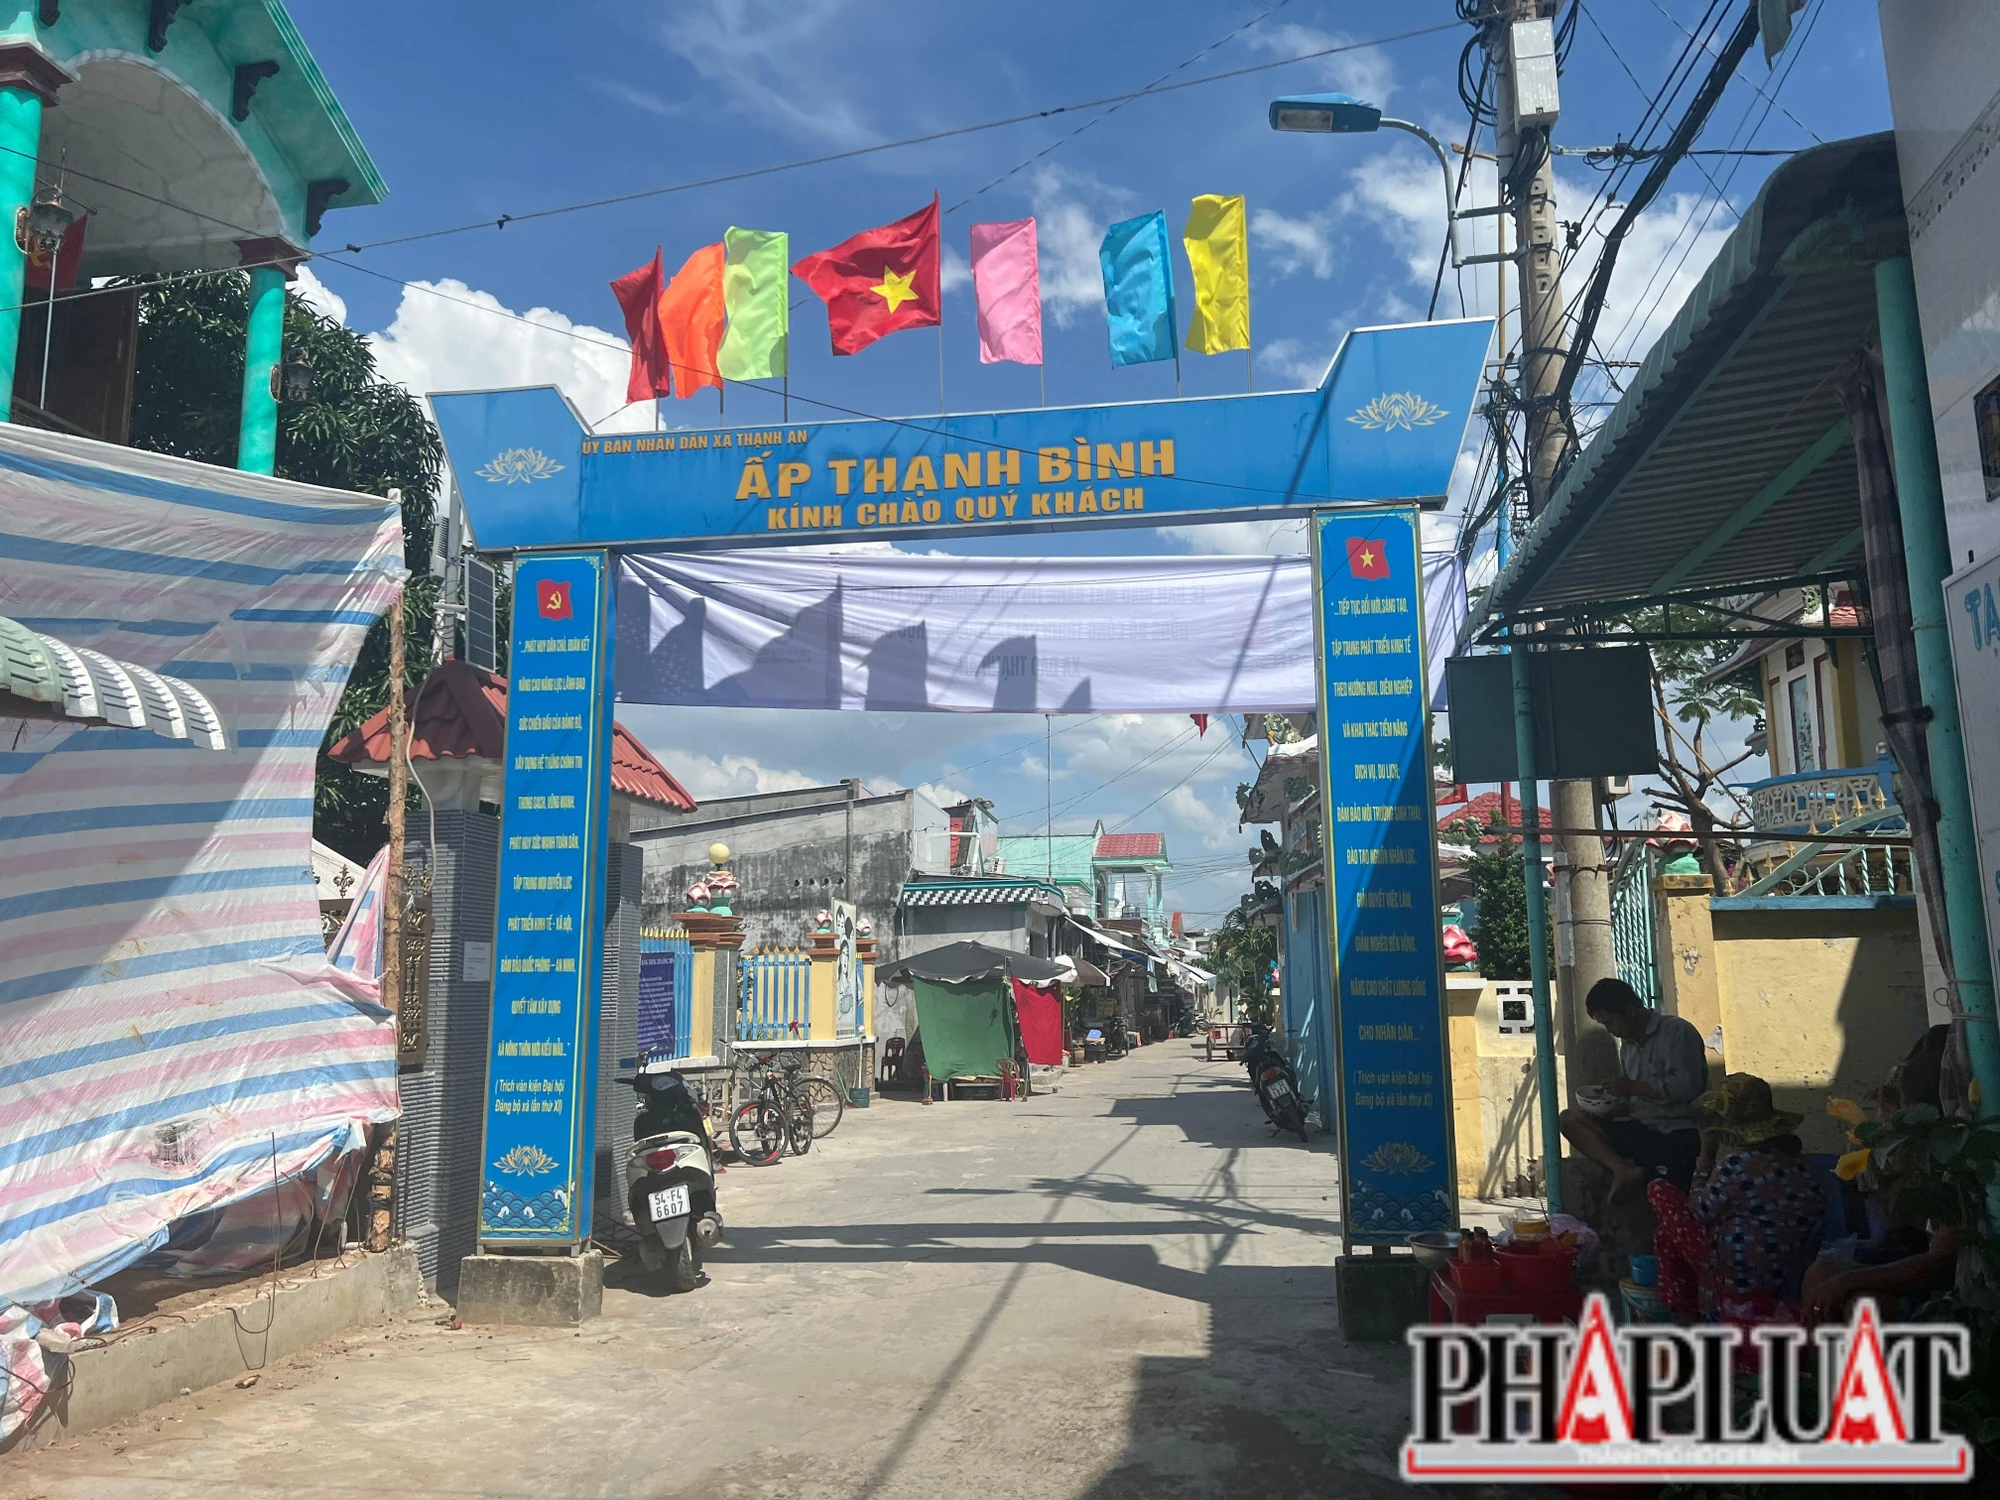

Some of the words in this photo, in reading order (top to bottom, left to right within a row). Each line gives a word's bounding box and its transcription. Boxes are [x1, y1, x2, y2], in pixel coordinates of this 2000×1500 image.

[603, 440, 632, 454] BAN
[636, 435, 676, 452] NHÂN
[679, 434, 708, 450] DÂN
[713, 431, 732, 448] XÃ
[736, 431, 782, 449] THẠNH
[787, 430, 807, 444] AN
[735, 451, 812, 500] ẤP
[828, 449, 1021, 497] THẠNH
[1038, 437, 1175, 483] BÌNH
[768, 502, 842, 530] KÍNH
[857, 497, 941, 525] CHÀO
[955, 489, 1019, 522] QUÝ
[1032, 486, 1144, 516] KHÁCH
[1359, 1025, 1374, 1040] CHO
[1375, 1022, 1396, 1040] NHÂN
[516, 1079, 527, 1092] văn
[528, 1079, 541, 1095] kiện
[543, 1079, 554, 1094] Đại
[554, 1079, 565, 1095] hội
[1377, 1070, 1390, 1084] văn
[1391, 1071, 1406, 1087] kiện
[1408, 1071, 1420, 1087] Đại
[1421, 1071, 1433, 1087] hội
[495, 1098, 511, 1114] Đảng
[512, 1099, 521, 1115] bộ
[522, 1099, 530, 1112] xã
[530, 1096, 540, 1112] lần
[541, 1099, 553, 1112] thứ
[1356, 1091, 1373, 1109] Đảng
[1375, 1092, 1385, 1109] bộ
[1386, 1092, 1395, 1106] xã
[1397, 1090, 1407, 1106] lần
[1409, 1092, 1422, 1106] thứ
[654, 1189, 682, 1206] 54-F4
[656, 1201, 683, 1218] 6607
